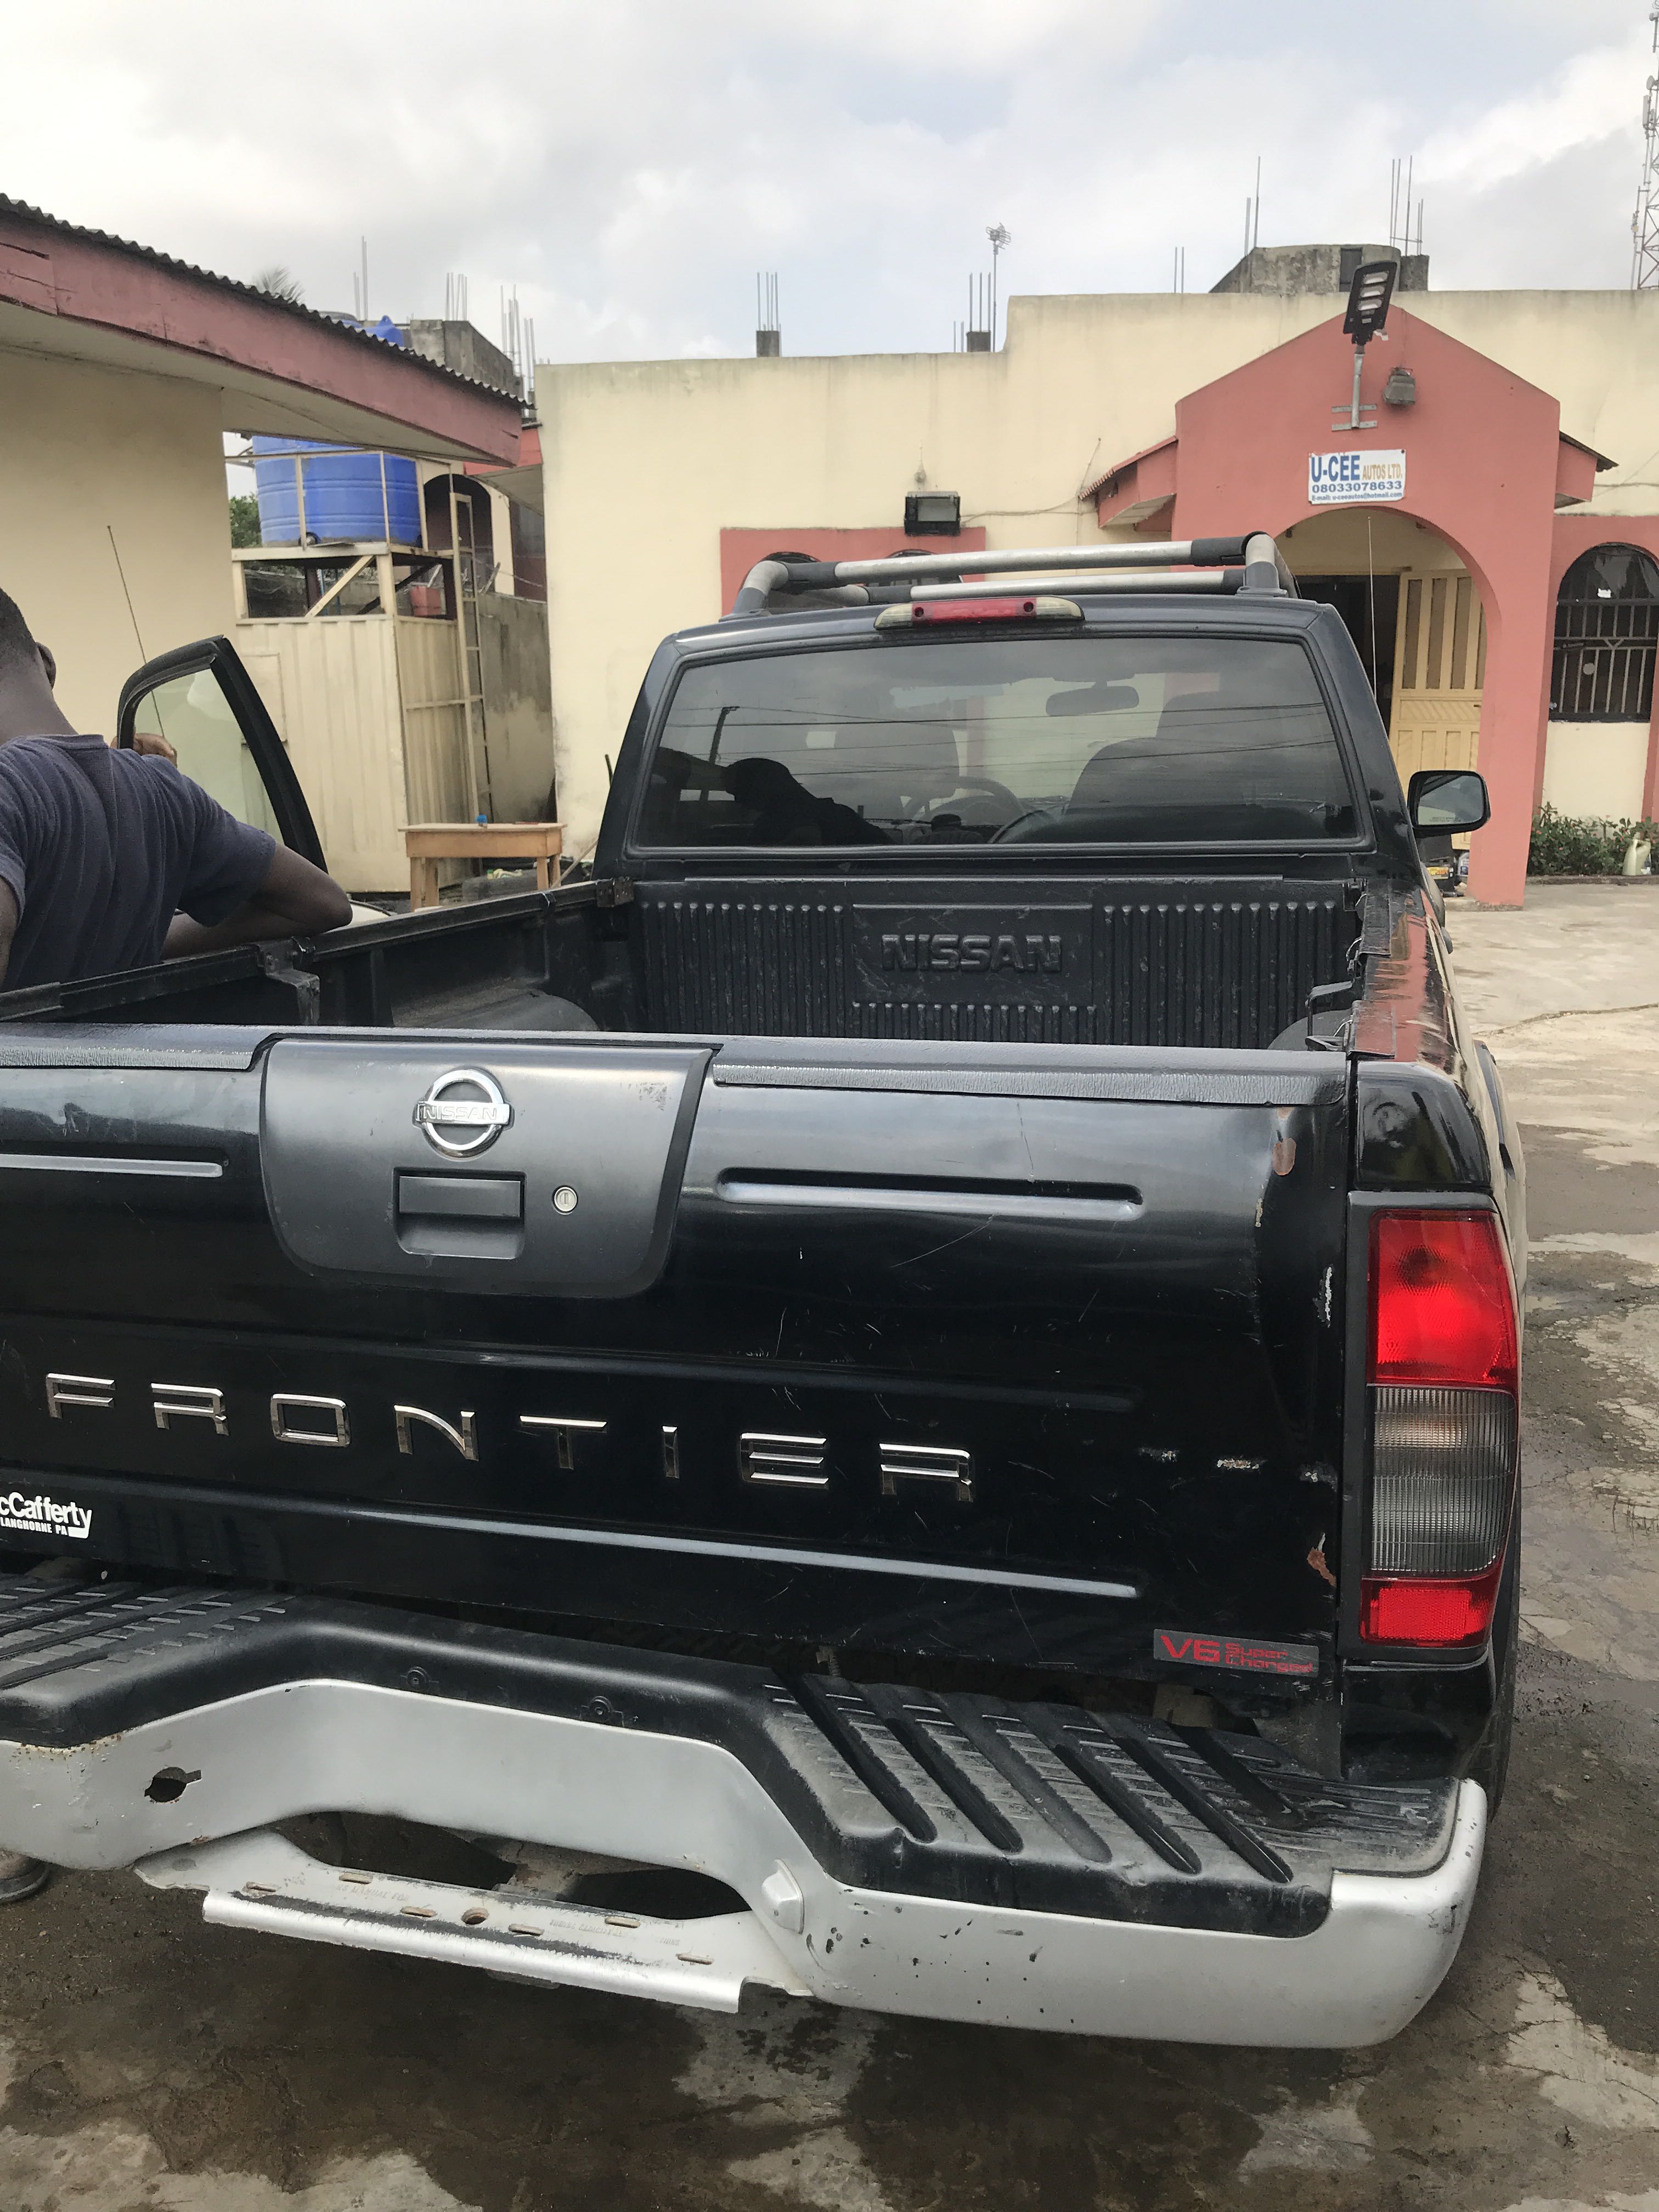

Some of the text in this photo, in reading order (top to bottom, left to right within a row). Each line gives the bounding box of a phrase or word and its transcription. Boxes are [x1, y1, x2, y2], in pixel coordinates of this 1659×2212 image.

[1311, 455, 1361, 482] U-CEE
[1362, 464, 1386, 481] AUTOS
[1312, 481, 1402, 493] 08033078633
[882, 934, 1062, 972] NISSAN
[423, 1105, 498, 1120] NISSAN
[46, 1372, 973, 1503] FRONTIER
[0, 1516, 67, 1536] LANGHORNE PA
[1160, 1635, 1220, 1663] V6
[1225, 1643, 1289, 1659] Super
[1224, 1653, 1313, 1673] Charged
